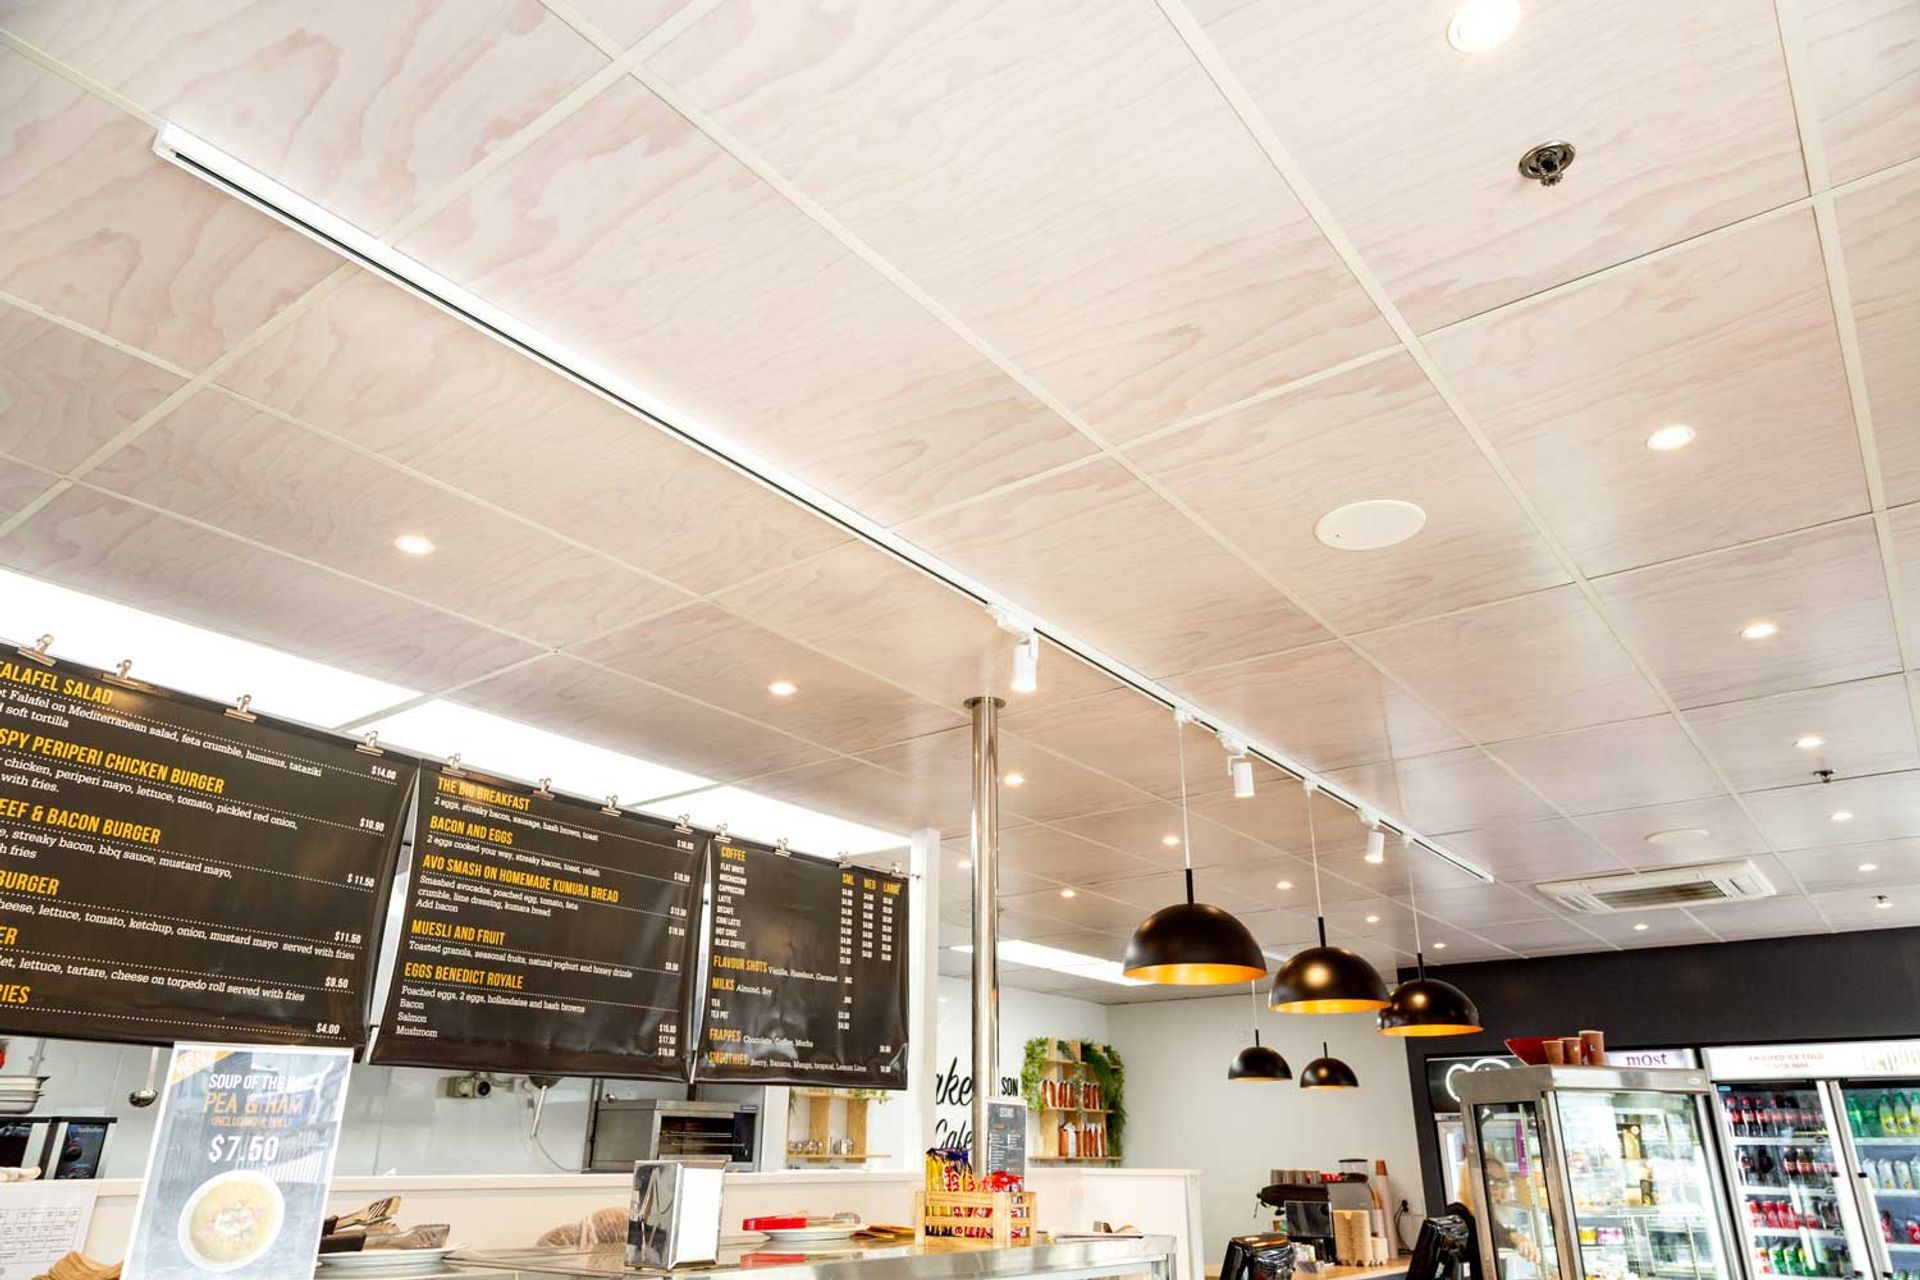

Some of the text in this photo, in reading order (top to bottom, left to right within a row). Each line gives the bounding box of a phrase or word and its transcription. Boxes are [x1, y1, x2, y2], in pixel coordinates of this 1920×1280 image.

[63, 679, 113, 704] SALAD
[6, 706, 28, 718] soft
[31, 710, 69, 728] tortilla
[9, 690, 49, 708] Falafel
[52, 703, 65, 713] on
[68, 704, 147, 733] Mediterranean
[149, 727, 179, 742] salad,
[181, 734, 200, 747] feta
[203, 741, 243, 758] crumble,
[245, 750, 287, 769] hummus,
[32, 736, 104, 767] PERIPERI
[105, 753, 168, 781] CHICKEN
[170, 768, 225, 794] BURGER
[1, 773, 60, 793] with fries.
[4, 758, 298, 832] chicken, periperi mayo, lettuce, tomato, pickled red onion,
[437, 777, 530, 811] THE BIG BREAKFAST
[434, 797, 440, 806] 2
[440, 800, 460, 811] eggs,
[462, 804, 487, 818] streaky
[489, 809, 511, 823] bacon,
[31, 805, 161, 844] & BACON BURGER
[430, 816, 513, 845] BACON AND EGGS
[10, 845, 37, 859] fries
[12, 830, 232, 879] streaky bacon, bbq sauce, mustard mayo,
[427, 835, 432, 844] 2
[434, 838, 452, 848] eggs
[454, 841, 480, 853] cooked
[481, 846, 496, 857] your
[515, 853, 540, 866] streaky
[721, 847, 747, 862] COFFEE
[422, 854, 619, 902] AVO SMASH ON HOMEMADE KUMURA BREAD
[416, 899, 458, 912] Add bacon
[417, 888, 451, 900] crumble,
[453, 892, 470, 903] lime
[531, 906, 551, 917] bread
[420, 875, 456, 889] Smashed
[493, 888, 523, 902] poached
[565, 899, 578, 910] feta
[39, 904, 355, 960] lettuce, tomato, ketchup, onion, mustard mayo served with fries
[412, 919, 505, 946] MUESLI AND FRUIT
[409, 940, 441, 954] Toasted
[442, 946, 472, 958] granola,
[474, 950, 506, 962] seasonal
[528, 957, 552, 968] natural
[553, 961, 578, 973] yoghurt
[580, 964, 592, 974] and
[593, 966, 612, 976] honey
[713, 955, 767, 973] FLAVOUR SHOTS
[19, 958, 305, 1001] lettuce, tartare, cheese on torpedo roll served with fries
[405, 962, 523, 989] EGGS BENEDICT ROYALE
[712, 977, 735, 991] MILKS
[400, 998, 424, 1010] Bacon
[401, 985, 585, 1013] Poached eggs, 2 eggs, hollandaise and hash browns
[397, 1011, 427, 1023] Salmon
[396, 1025, 438, 1039] Mushroom
[709, 1028, 741, 1042] FRAPPES
[709, 1051, 748, 1067] SMOOTHIES
[209, 1074, 241, 1090] SOUP
[243, 1074, 259, 1090] OF
[1001, 1077, 1019, 1096] SON
[204, 1092, 237, 1113] PEA
[209, 1134, 279, 1164] $7.50
